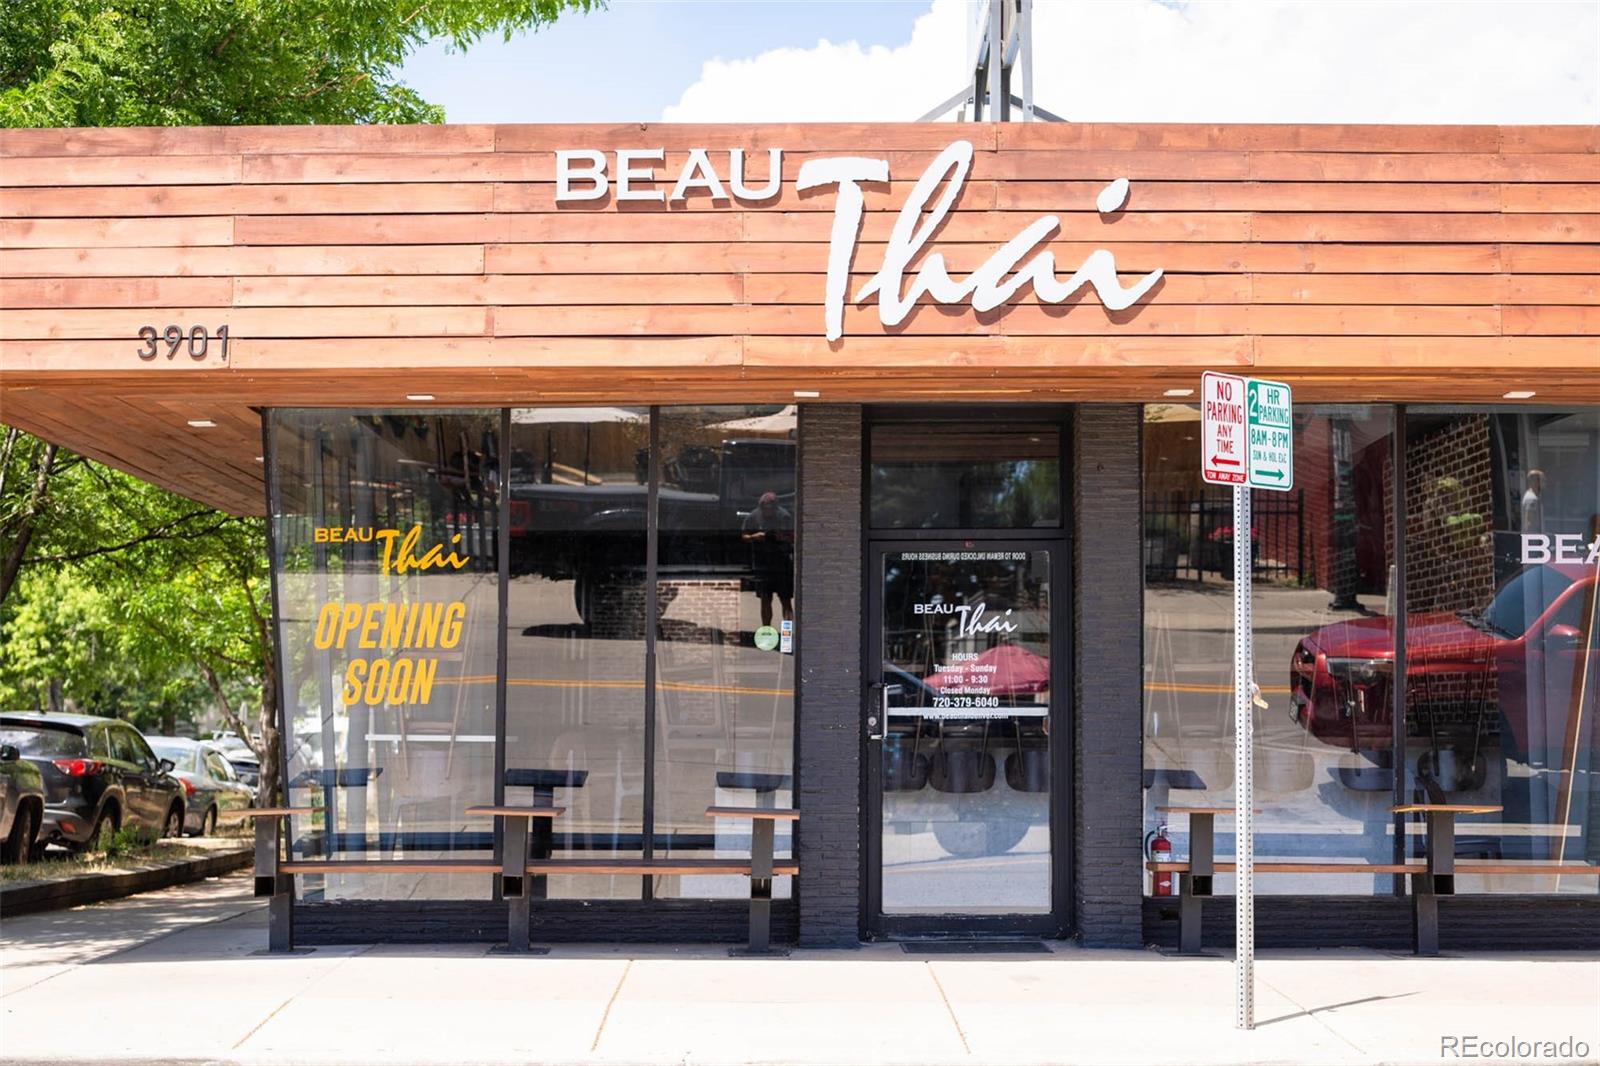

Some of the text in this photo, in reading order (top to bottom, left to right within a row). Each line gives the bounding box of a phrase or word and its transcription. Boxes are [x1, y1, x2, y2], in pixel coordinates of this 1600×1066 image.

[555, 140, 1164, 342] BEAU Thai
[137, 325, 229, 361] 3901
[1216, 381, 1233, 402] NO
[1207, 401, 1242, 424] PARKING
[1249, 388, 1280, 417] 2 HR
[1259, 404, 1289, 425] PARKING
[1216, 424, 1233, 439] ANY
[1216, 439, 1234, 454] TIME
[314, 523, 470, 577] BEAU Thai
[313, 602, 466, 650] OPENING
[914, 603, 1018, 638] BEAU Thai
[952, 653, 979, 661] HOURS
[934, 664, 963, 674] Tuesday
[970, 664, 997, 674] Sunday
[943, 675, 964, 684] 11:00
[971, 675, 989, 684] 9:30
[342, 658, 437, 705] SOON
[940, 686, 991, 696] Closed Monday
[932, 697, 999, 707] 720-379-6040
